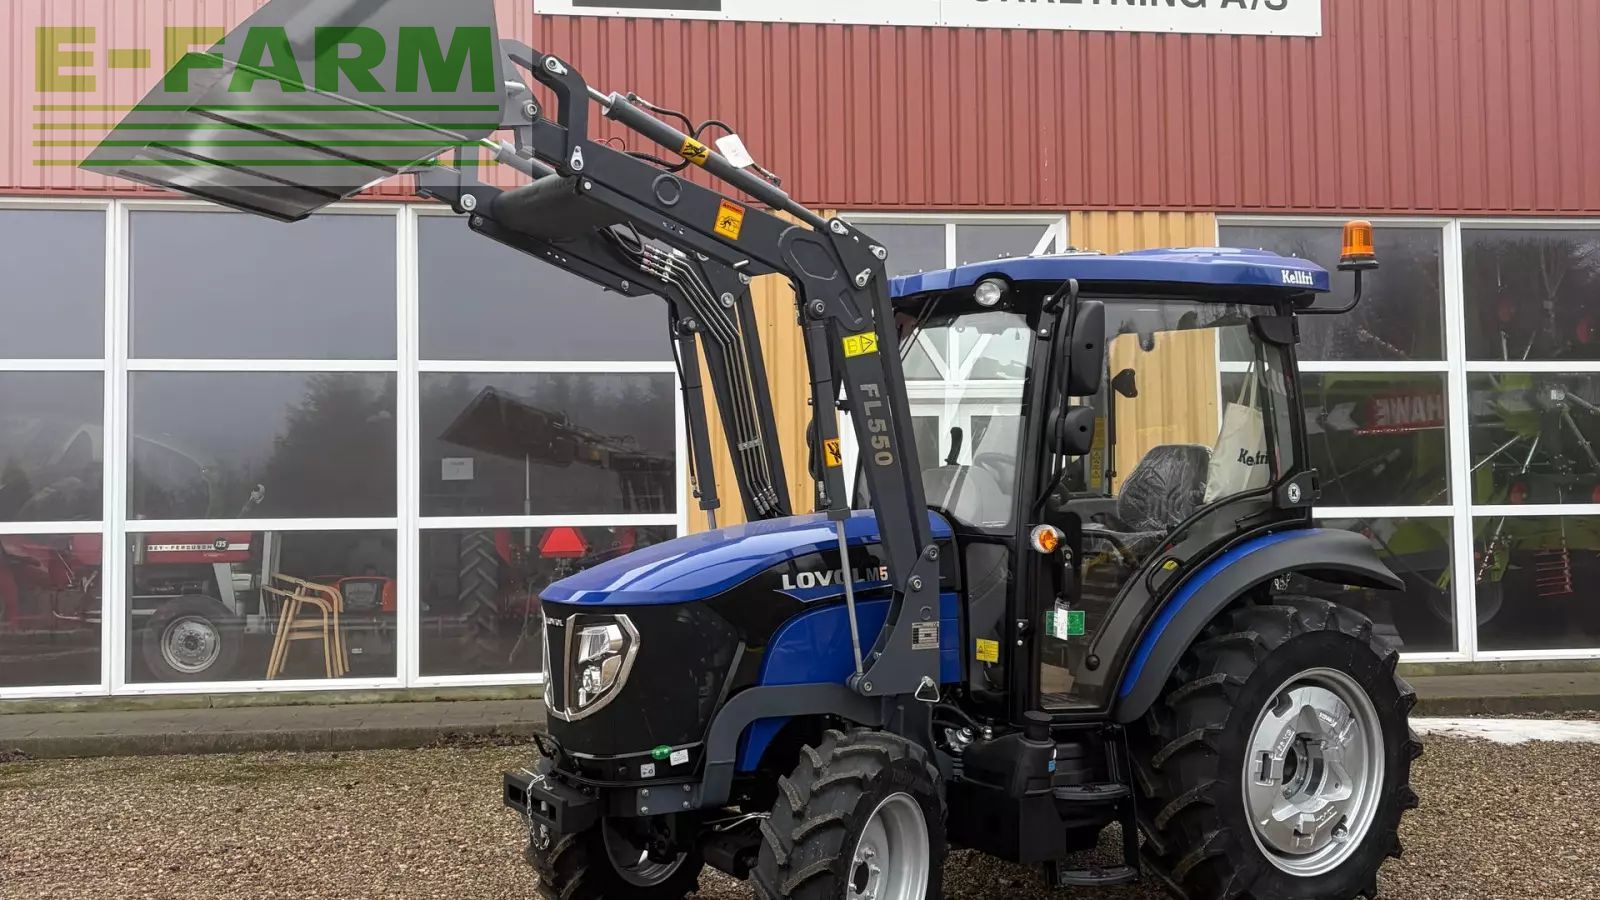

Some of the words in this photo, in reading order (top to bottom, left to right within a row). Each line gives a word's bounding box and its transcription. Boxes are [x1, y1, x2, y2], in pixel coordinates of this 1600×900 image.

[1281, 269, 1314, 285] Kellfri
[859, 383, 894, 466] FL550
[215, 540, 228, 548] 135
[781, 567, 866, 590] LOVOL
